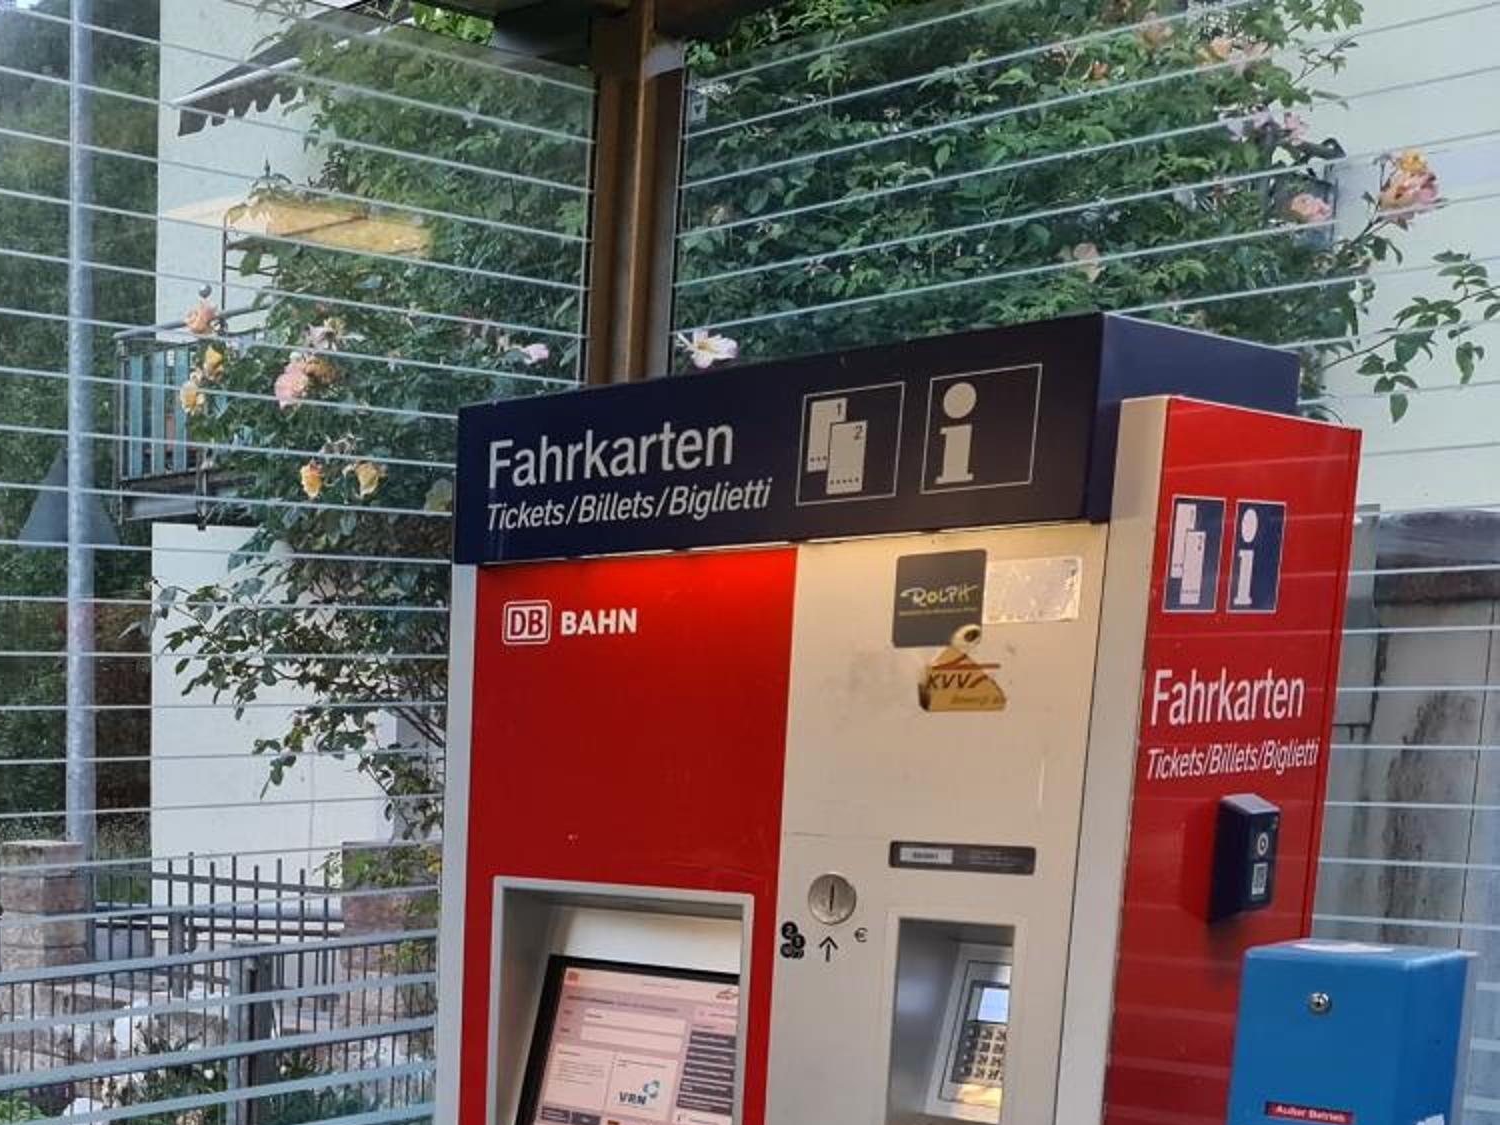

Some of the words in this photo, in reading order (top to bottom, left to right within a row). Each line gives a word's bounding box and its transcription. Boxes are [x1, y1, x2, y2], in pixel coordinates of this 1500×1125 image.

[488, 420, 734, 490] Fahrkarten
[486, 476, 773, 532] Tickets/Billets/Biglietti
[507, 605, 547, 639] DB
[560, 607, 638, 636] BAHN
[1150, 666, 1305, 727] Fahrkarten
[1146, 736, 1322, 781] Tickets/Billets/Biglietti
[617, 1090, 648, 1106] VRN
